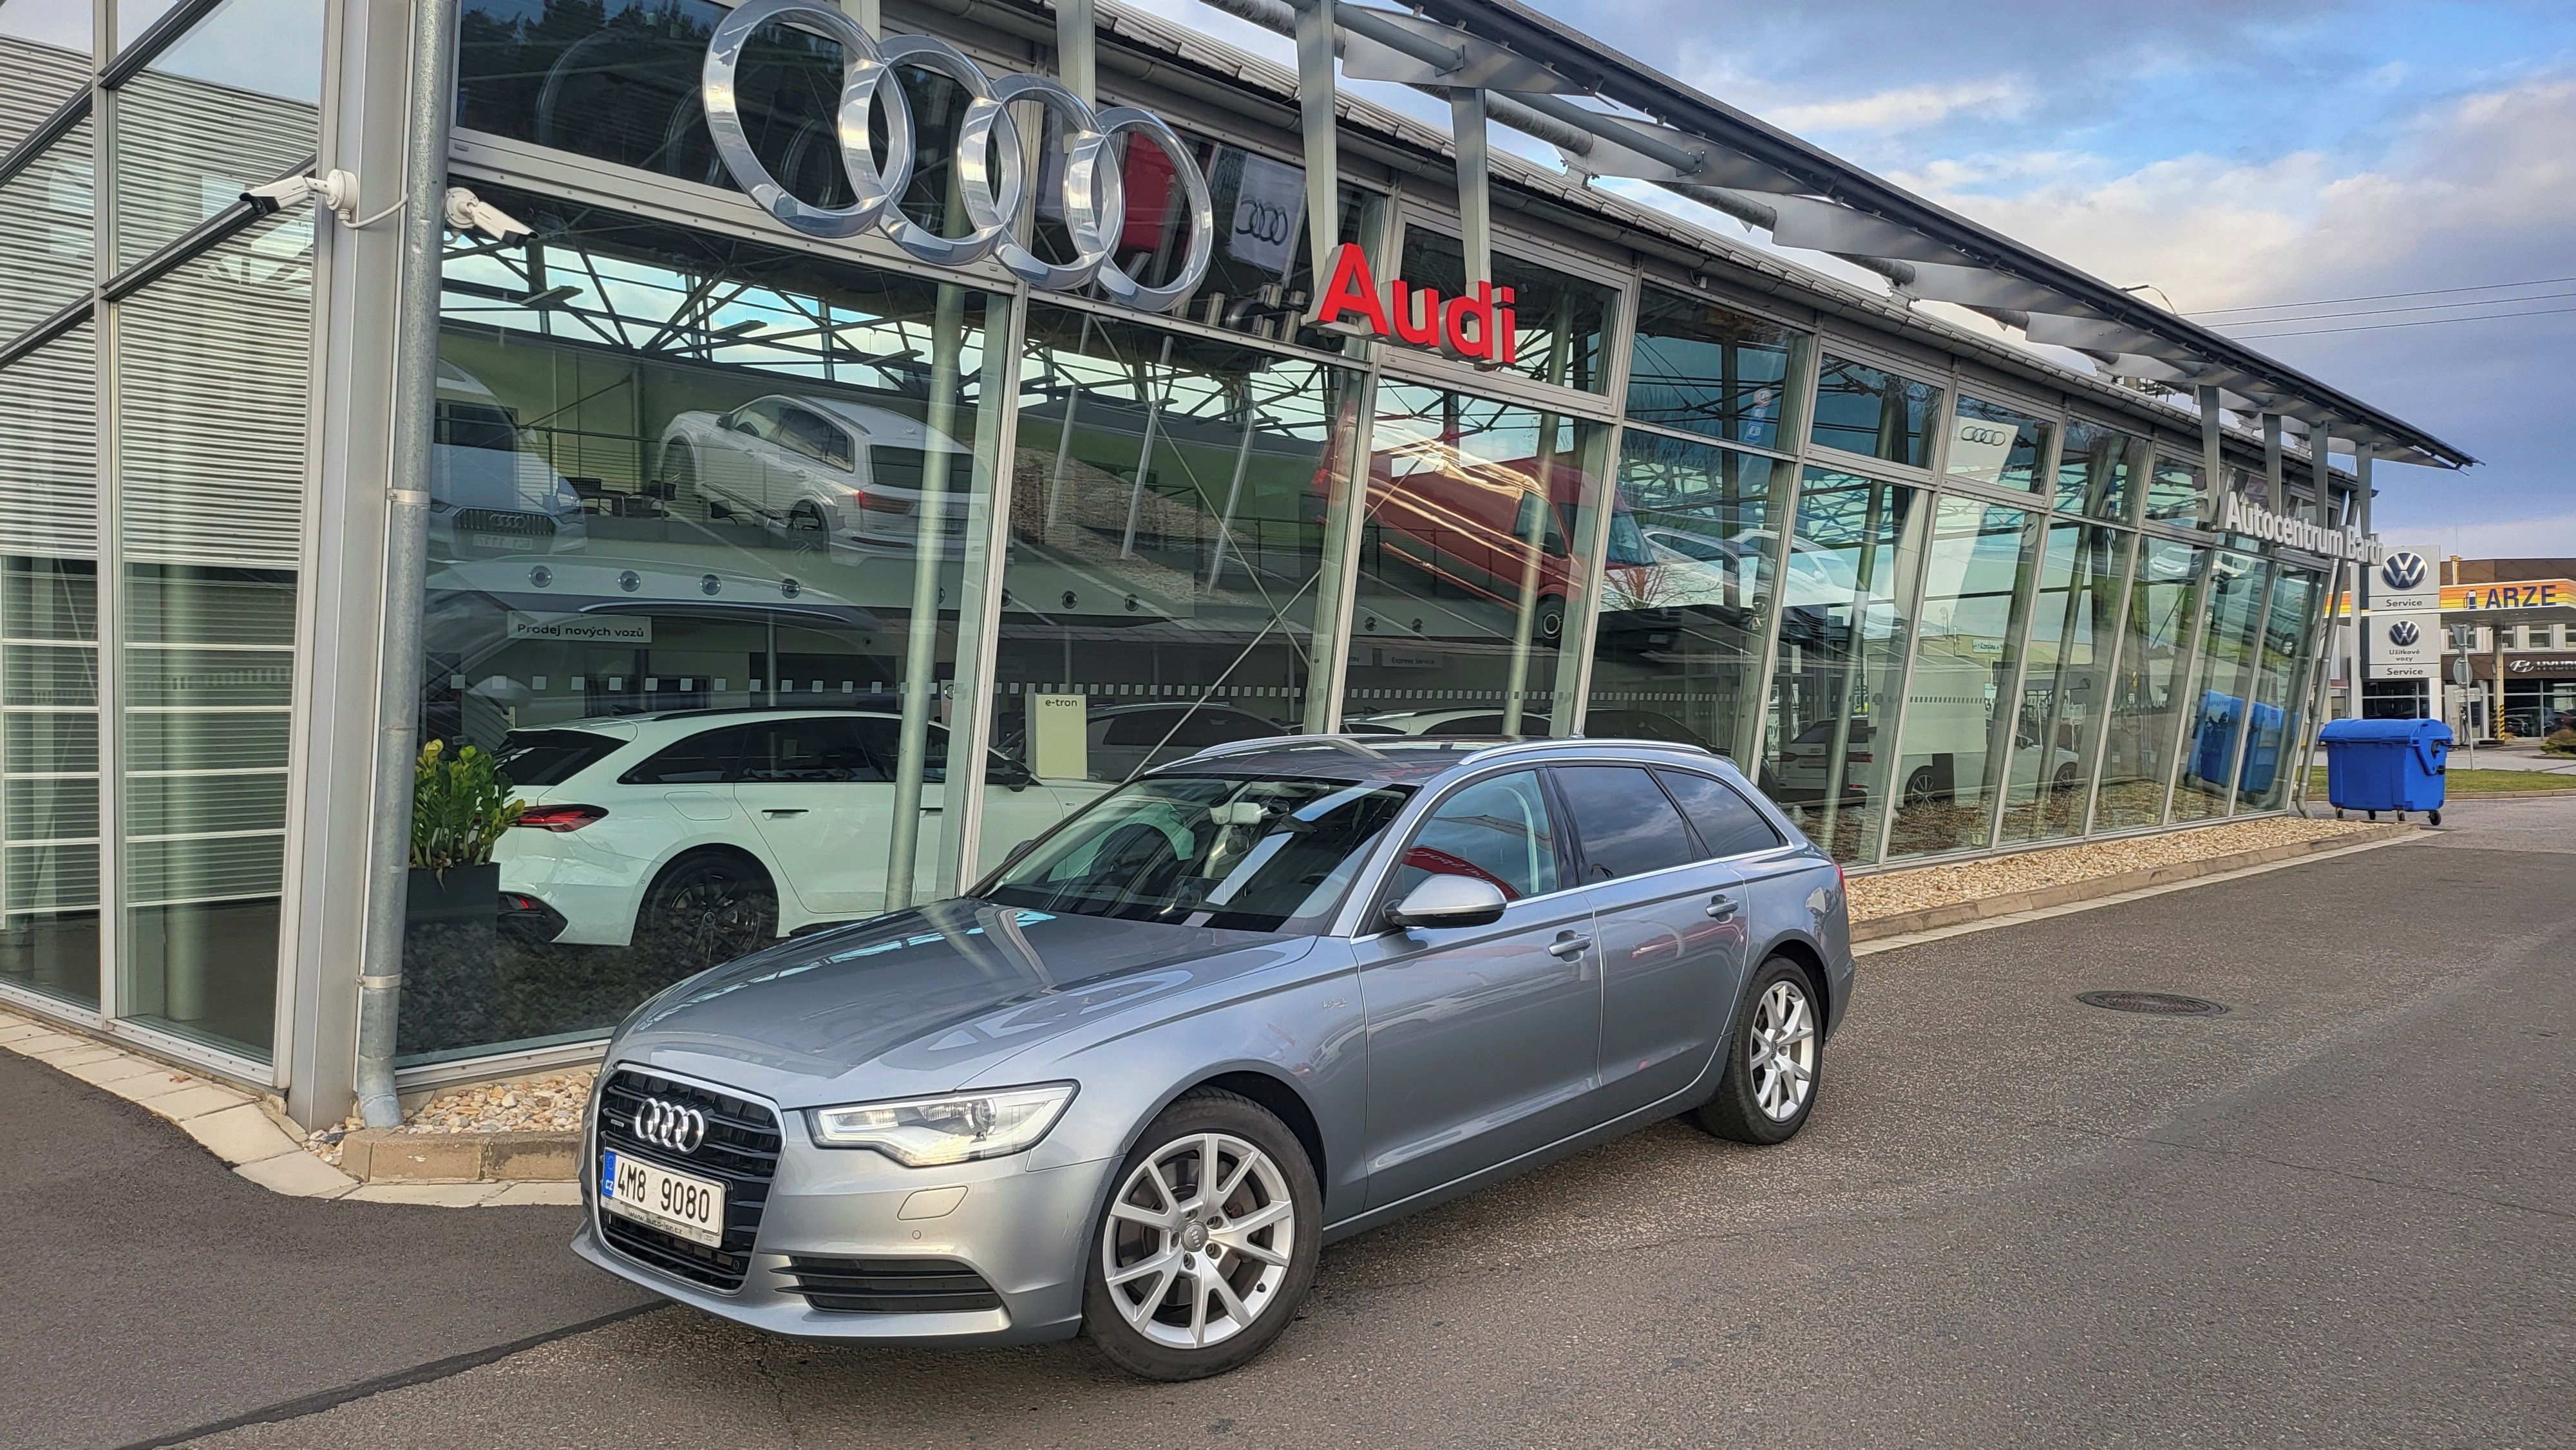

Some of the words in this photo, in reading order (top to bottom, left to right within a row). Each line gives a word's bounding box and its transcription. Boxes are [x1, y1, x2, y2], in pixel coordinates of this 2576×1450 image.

[1314, 242, 1516, 364] Audi
[2225, 491, 2344, 557] Autocentrum
[2385, 598, 2423, 607] Service
[2485, 585, 2556, 609] ARZE
[517, 623, 561, 637] Prodej
[565, 626, 611, 637] nových
[614, 628, 645, 637] vozů
[2387, 667, 2424, 675] Service
[2536, 661, 2576, 671] HYUN
[1045, 698, 1077, 707] e-tron
[605, 1178, 614, 1191] CZ
[618, 1162, 647, 1203] 4M8
[660, 1177, 710, 1223] 9080
